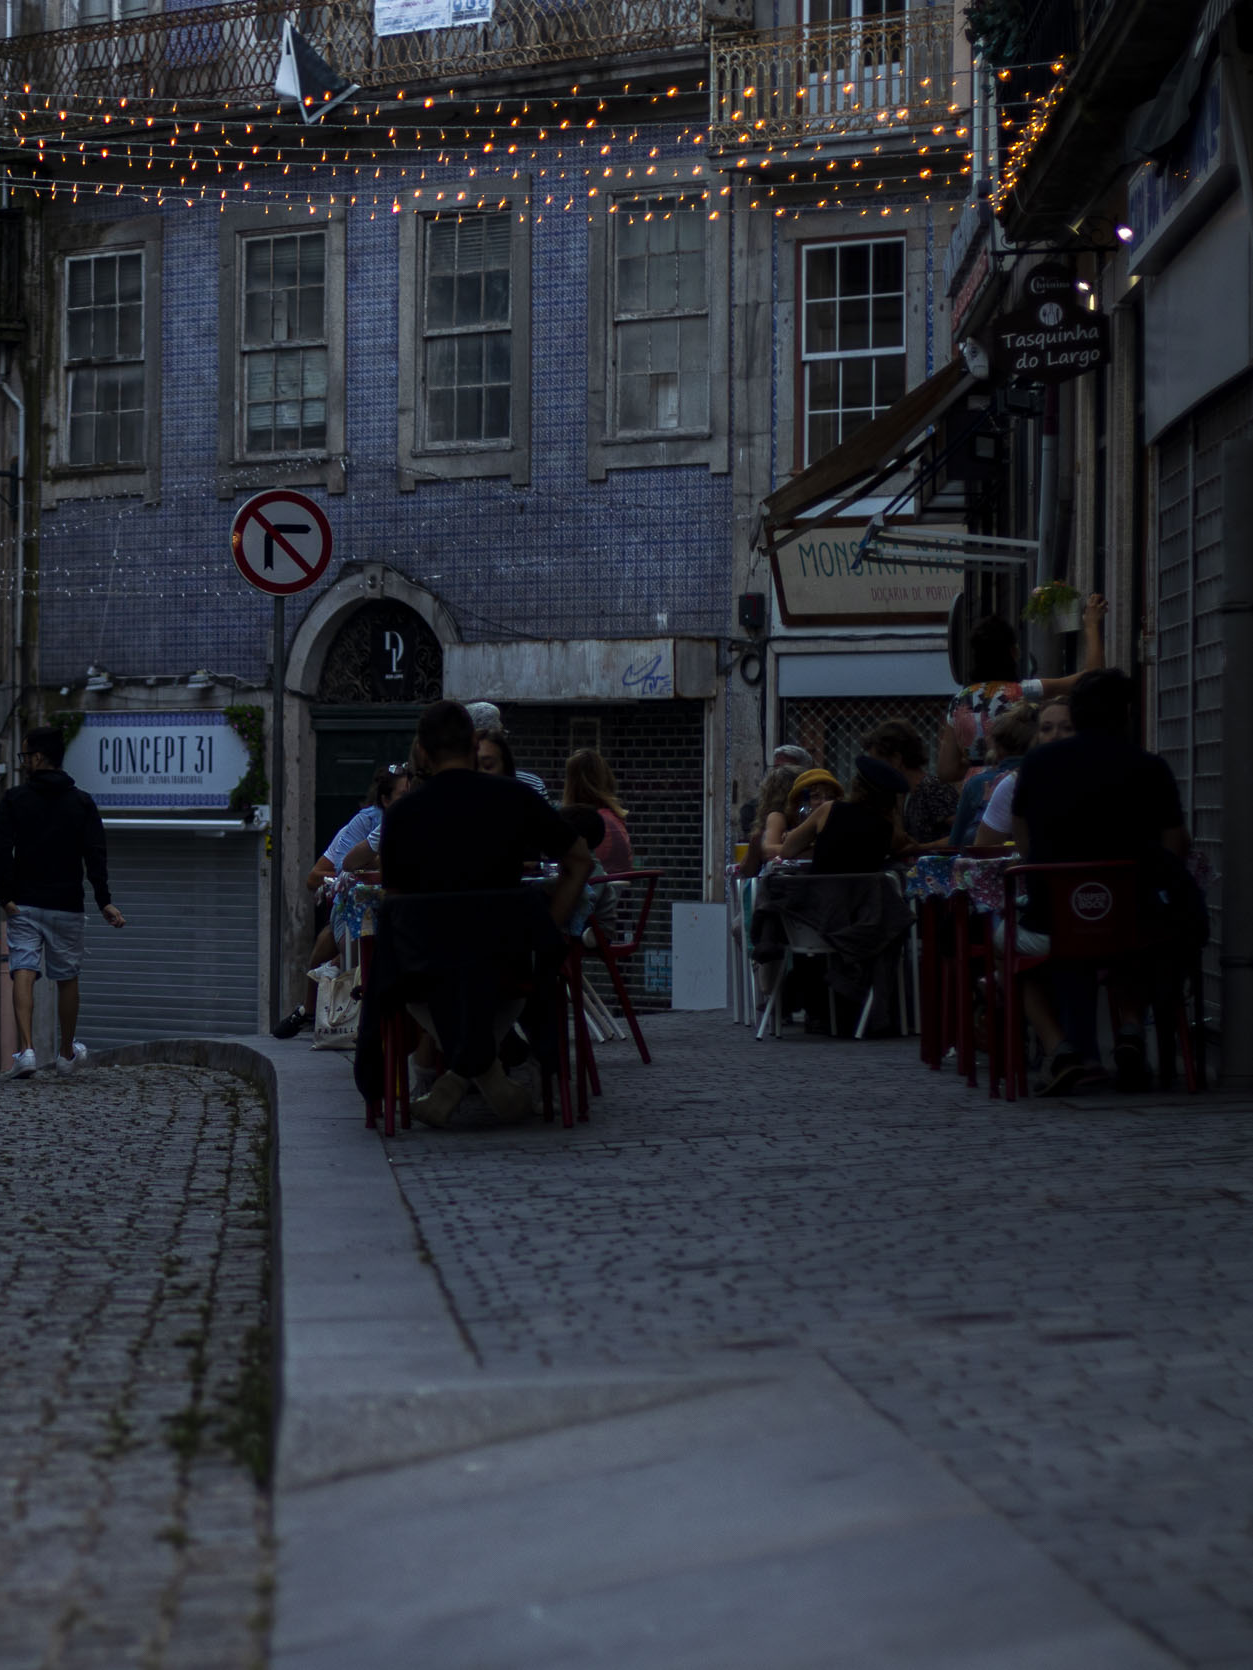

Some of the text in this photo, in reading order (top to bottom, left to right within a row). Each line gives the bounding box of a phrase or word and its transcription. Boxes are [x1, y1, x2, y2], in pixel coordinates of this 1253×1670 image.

[1001, 323, 1099, 350] Tasquinha
[1016, 348, 1100, 369] do Largo
[871, 586, 909, 603] DOÇARIA
[99, 736, 213, 774] CONCEPT 31
